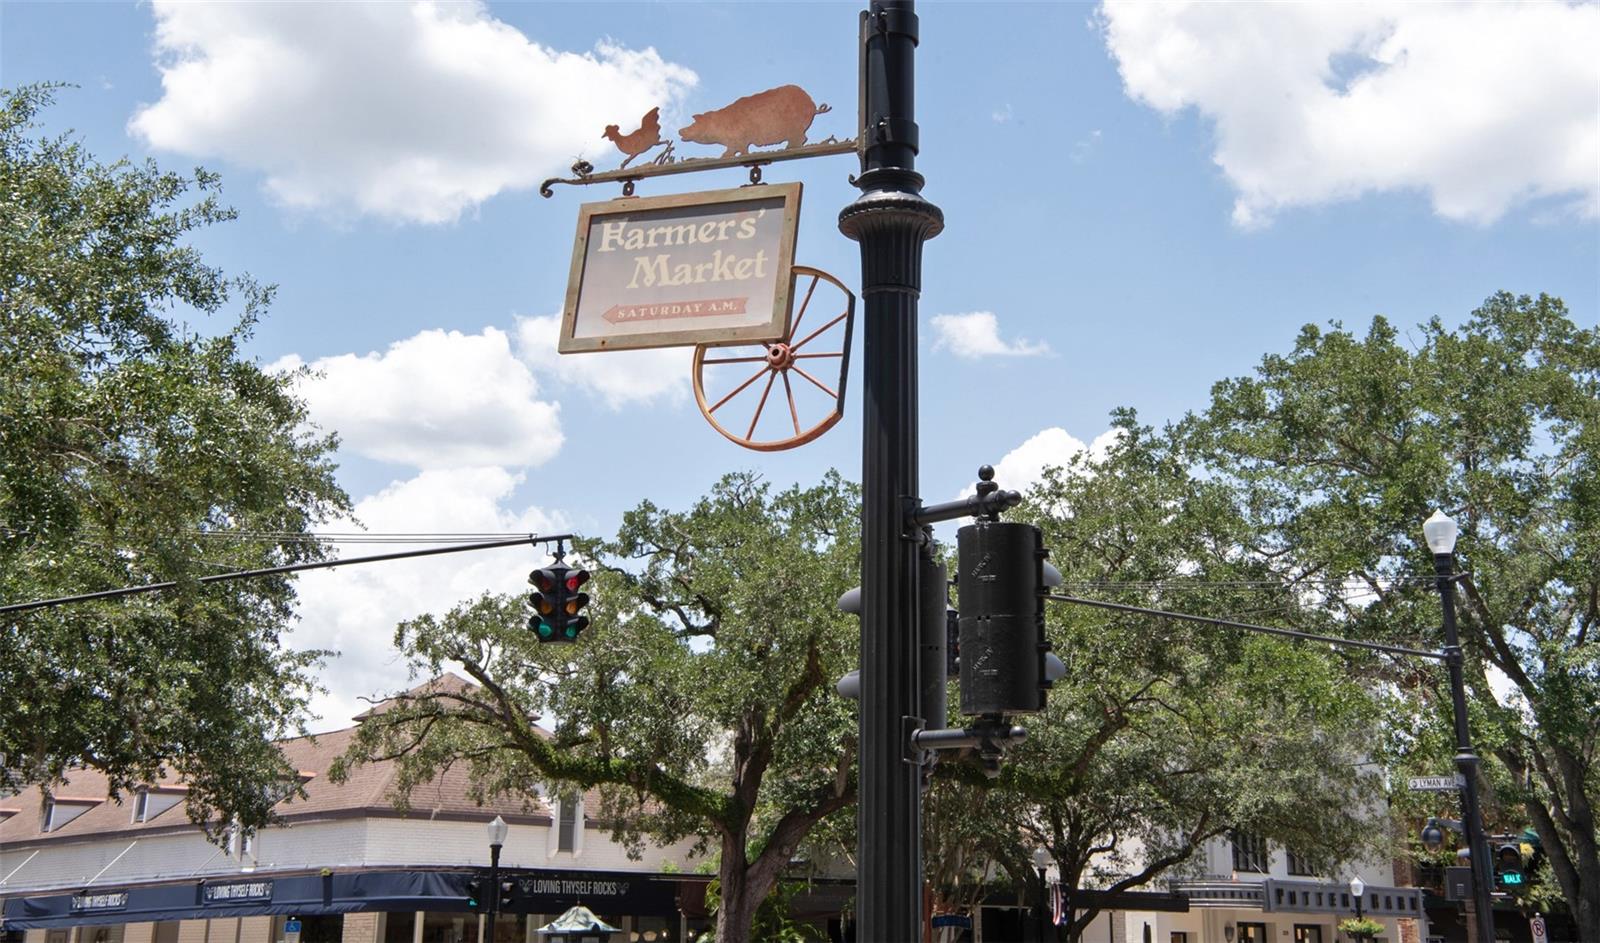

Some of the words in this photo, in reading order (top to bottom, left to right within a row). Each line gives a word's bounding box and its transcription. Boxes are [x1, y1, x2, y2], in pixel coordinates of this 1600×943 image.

[597, 208, 766, 252] Farmers'
[626, 249, 768, 289] Market
[617, 303, 703, 318] SATURDAY
[707, 301, 737, 313] A.M.
[1420, 778, 1441, 787] LYMAN
[1503, 873, 1521, 884] WALK
[213, 885, 230, 899] LOVING
[230, 884, 249, 898] THYSELF
[249, 883, 265, 897] ROCKS
[533, 879, 560, 894] LOVING
[561, 880, 592, 894] THYSELF
[593, 881, 617, 895] ROCKS
